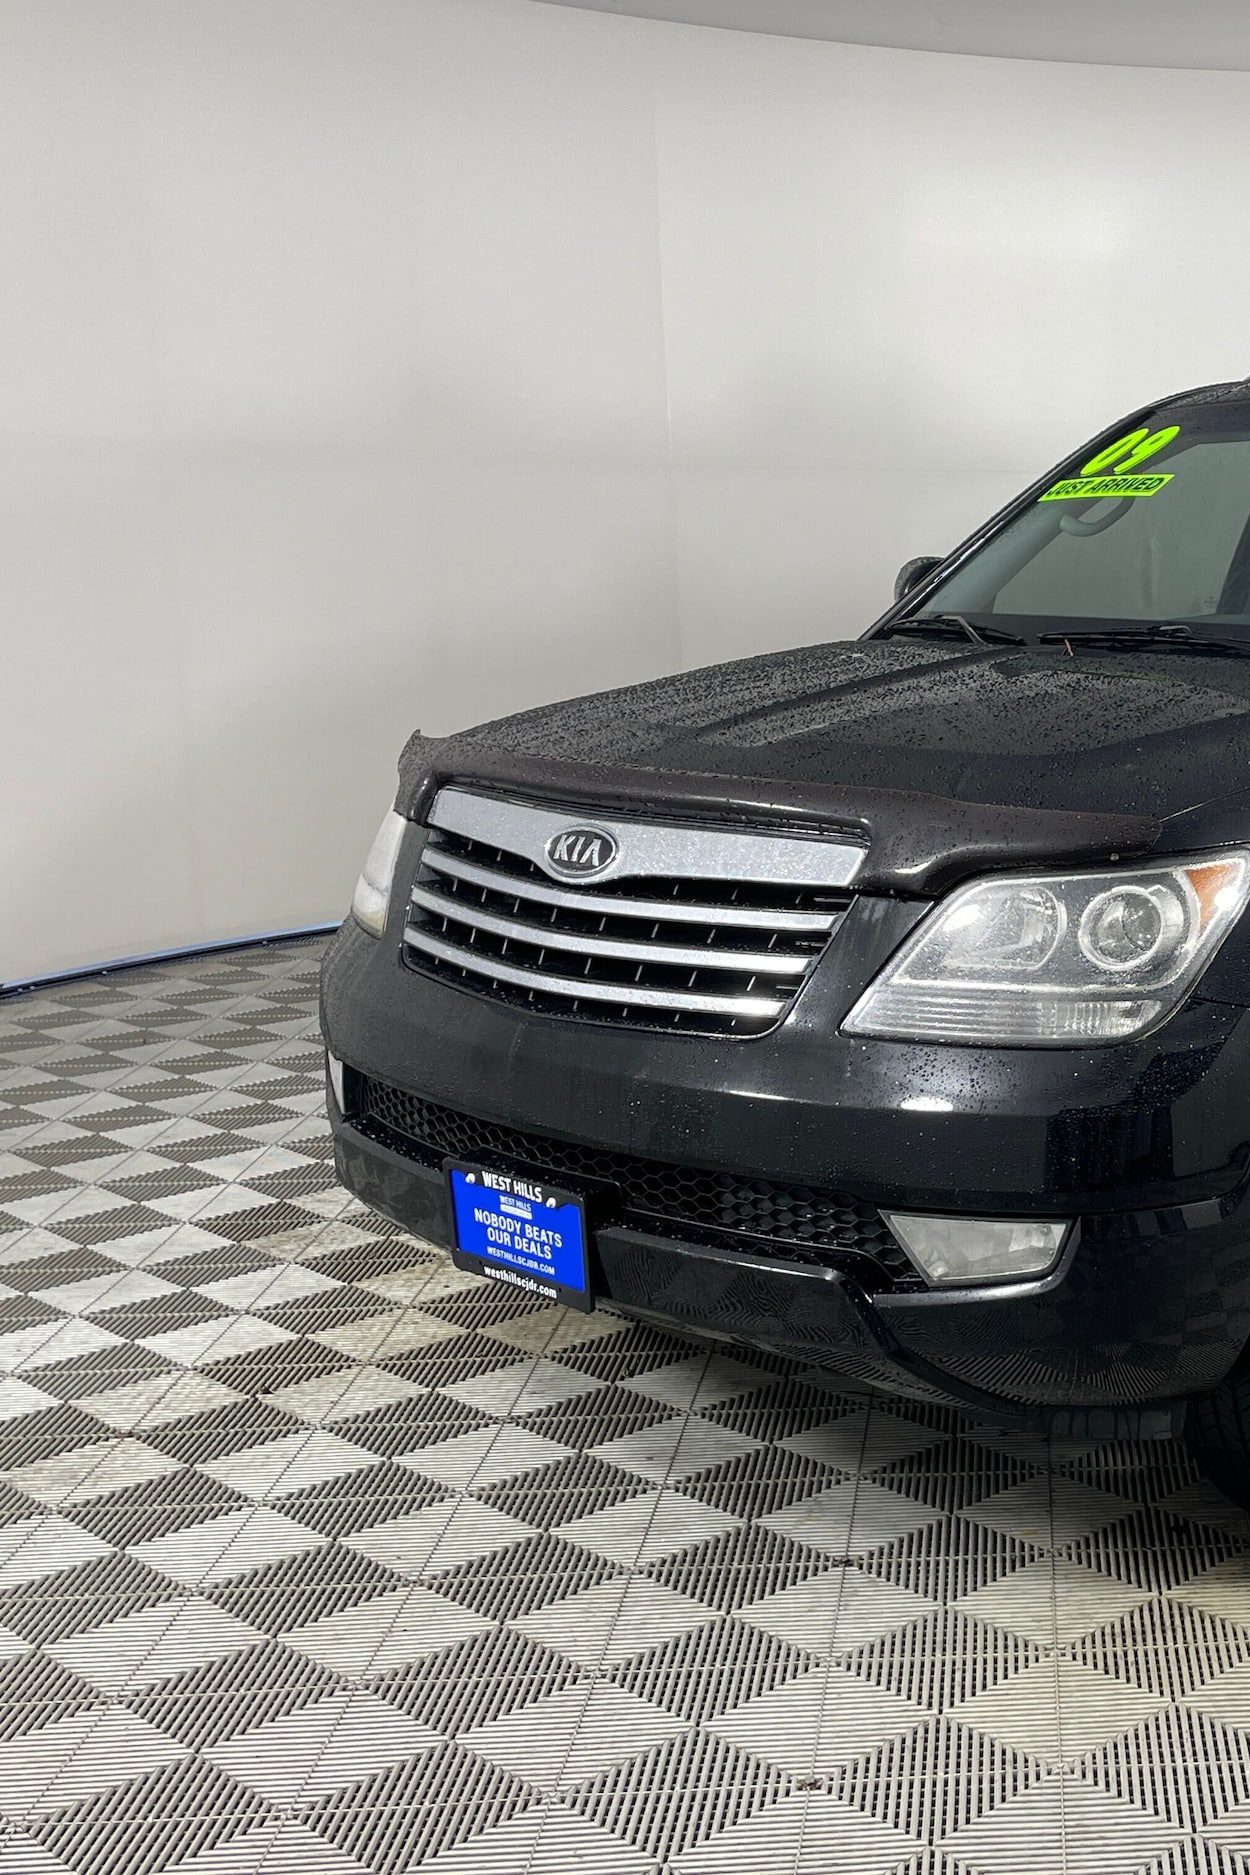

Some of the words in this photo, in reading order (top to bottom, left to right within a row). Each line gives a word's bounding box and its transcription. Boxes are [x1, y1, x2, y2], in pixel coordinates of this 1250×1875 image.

[1080, 425, 1181, 477] 09
[1046, 480, 1094, 497] JUST
[1088, 477, 1165, 494] ARRIVED
[553, 834, 602, 867] KIA
[482, 1170, 511, 1193] WEST
[513, 1182, 543, 1203] HILLS
[499, 1195, 515, 1206] WEST
[515, 1199, 532, 1212] HILLS
[474, 1208, 522, 1235] NOBODY
[525, 1223, 563, 1248] BEATS
[487, 1227, 512, 1247] OUR
[514, 1235, 552, 1260] DEALS
[487, 1245, 556, 1276] WESTHILLSCJDR.COM
[484, 1265, 558, 1299] westhillscjdr.com
